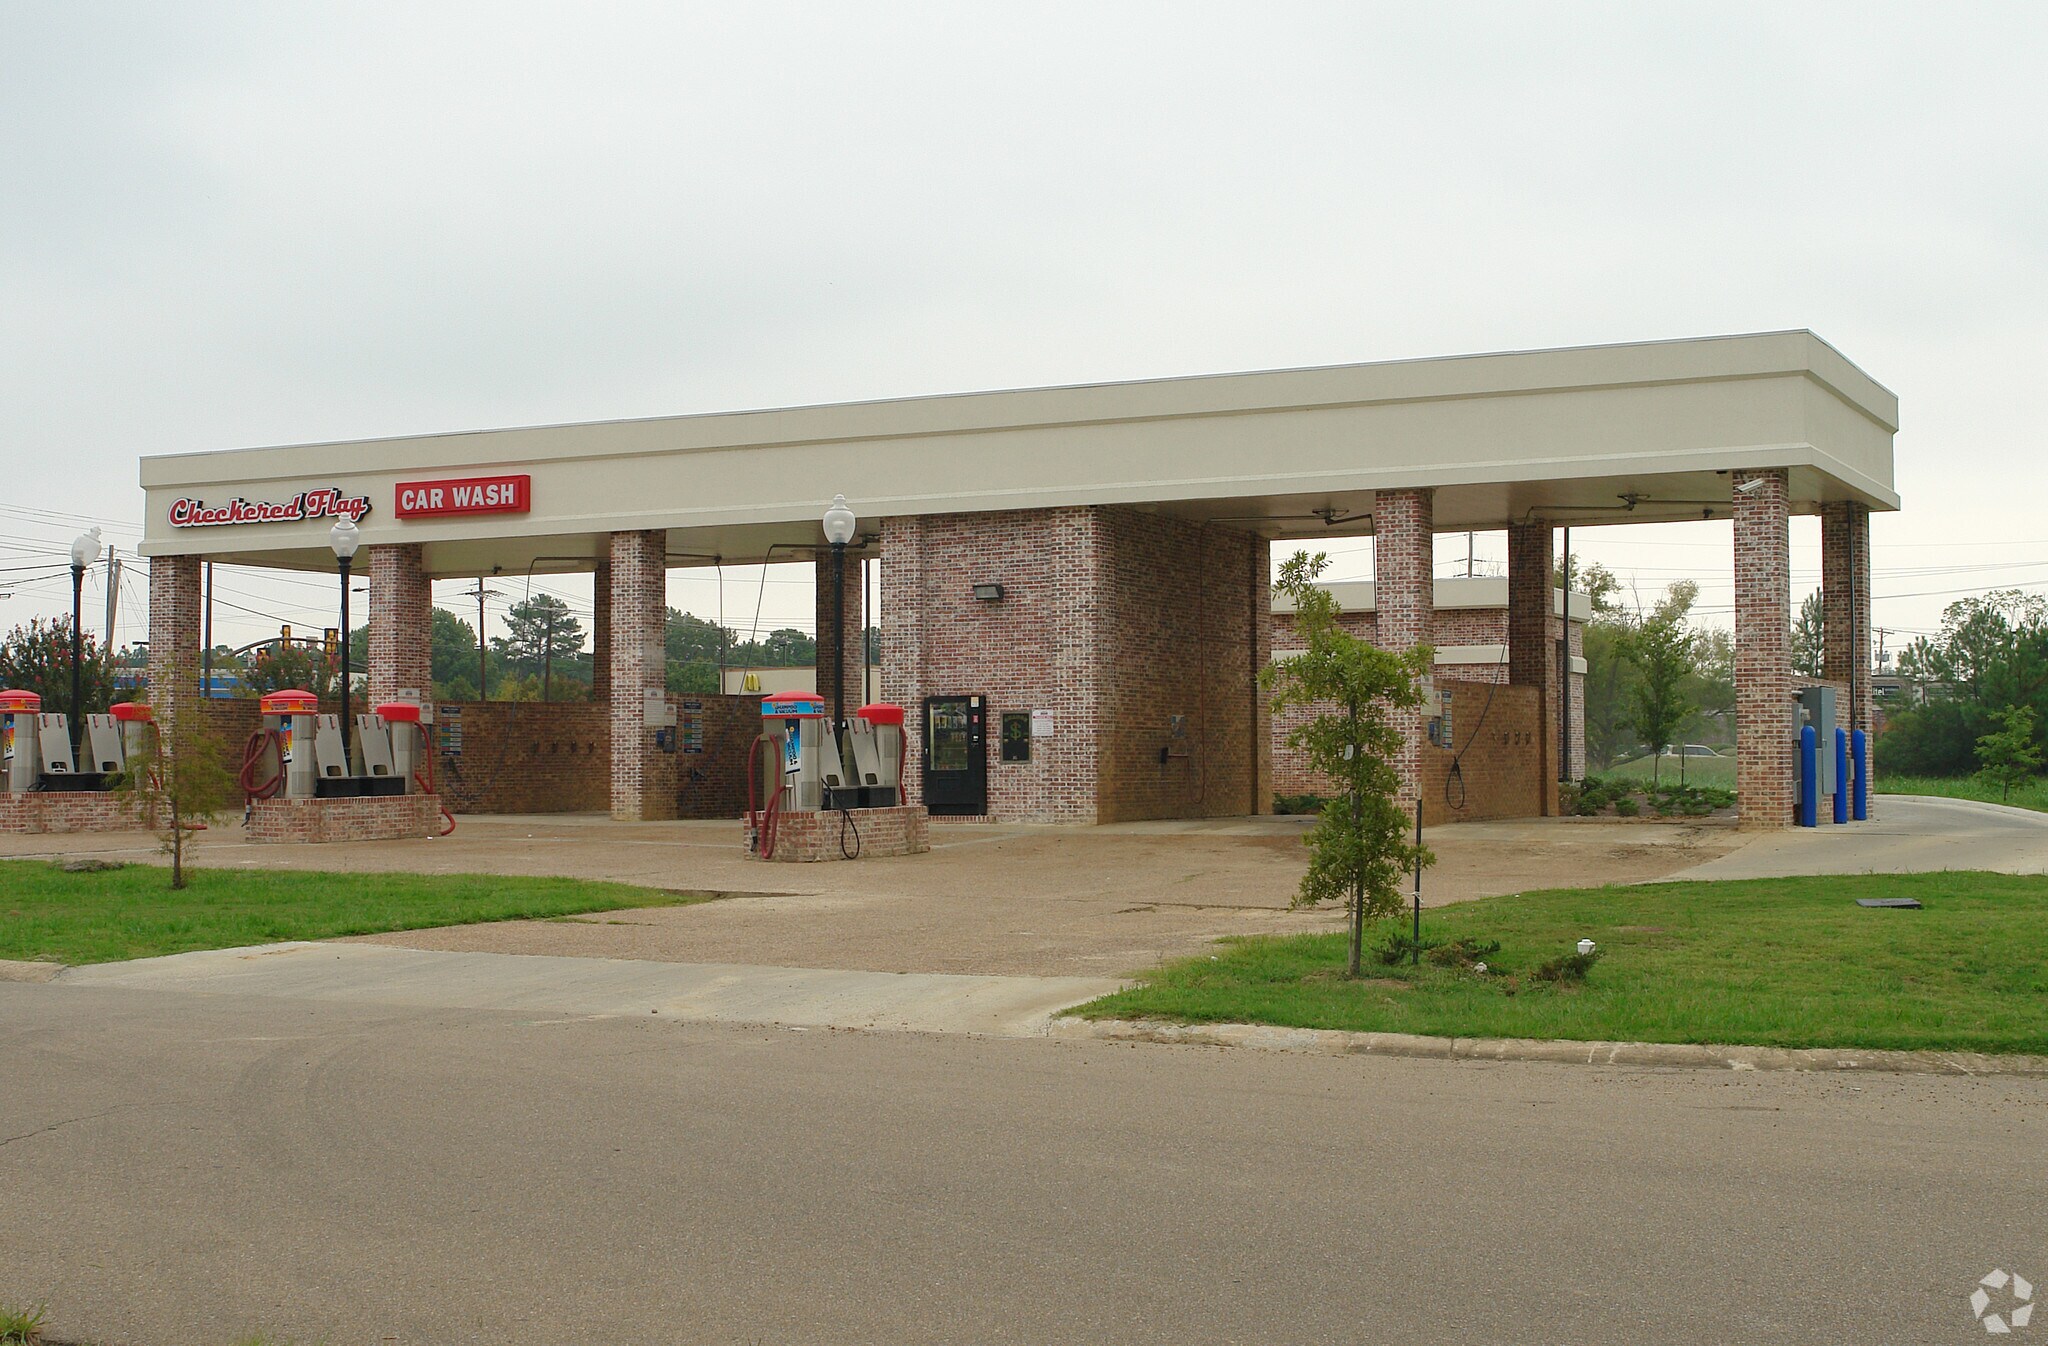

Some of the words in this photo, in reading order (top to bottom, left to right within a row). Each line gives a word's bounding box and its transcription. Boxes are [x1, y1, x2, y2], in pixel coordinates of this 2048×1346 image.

[168, 493, 307, 528] Checkered
[306, 488, 371, 522] Flag
[401, 488, 444, 511] CAR
[452, 483, 515, 508] WASH
